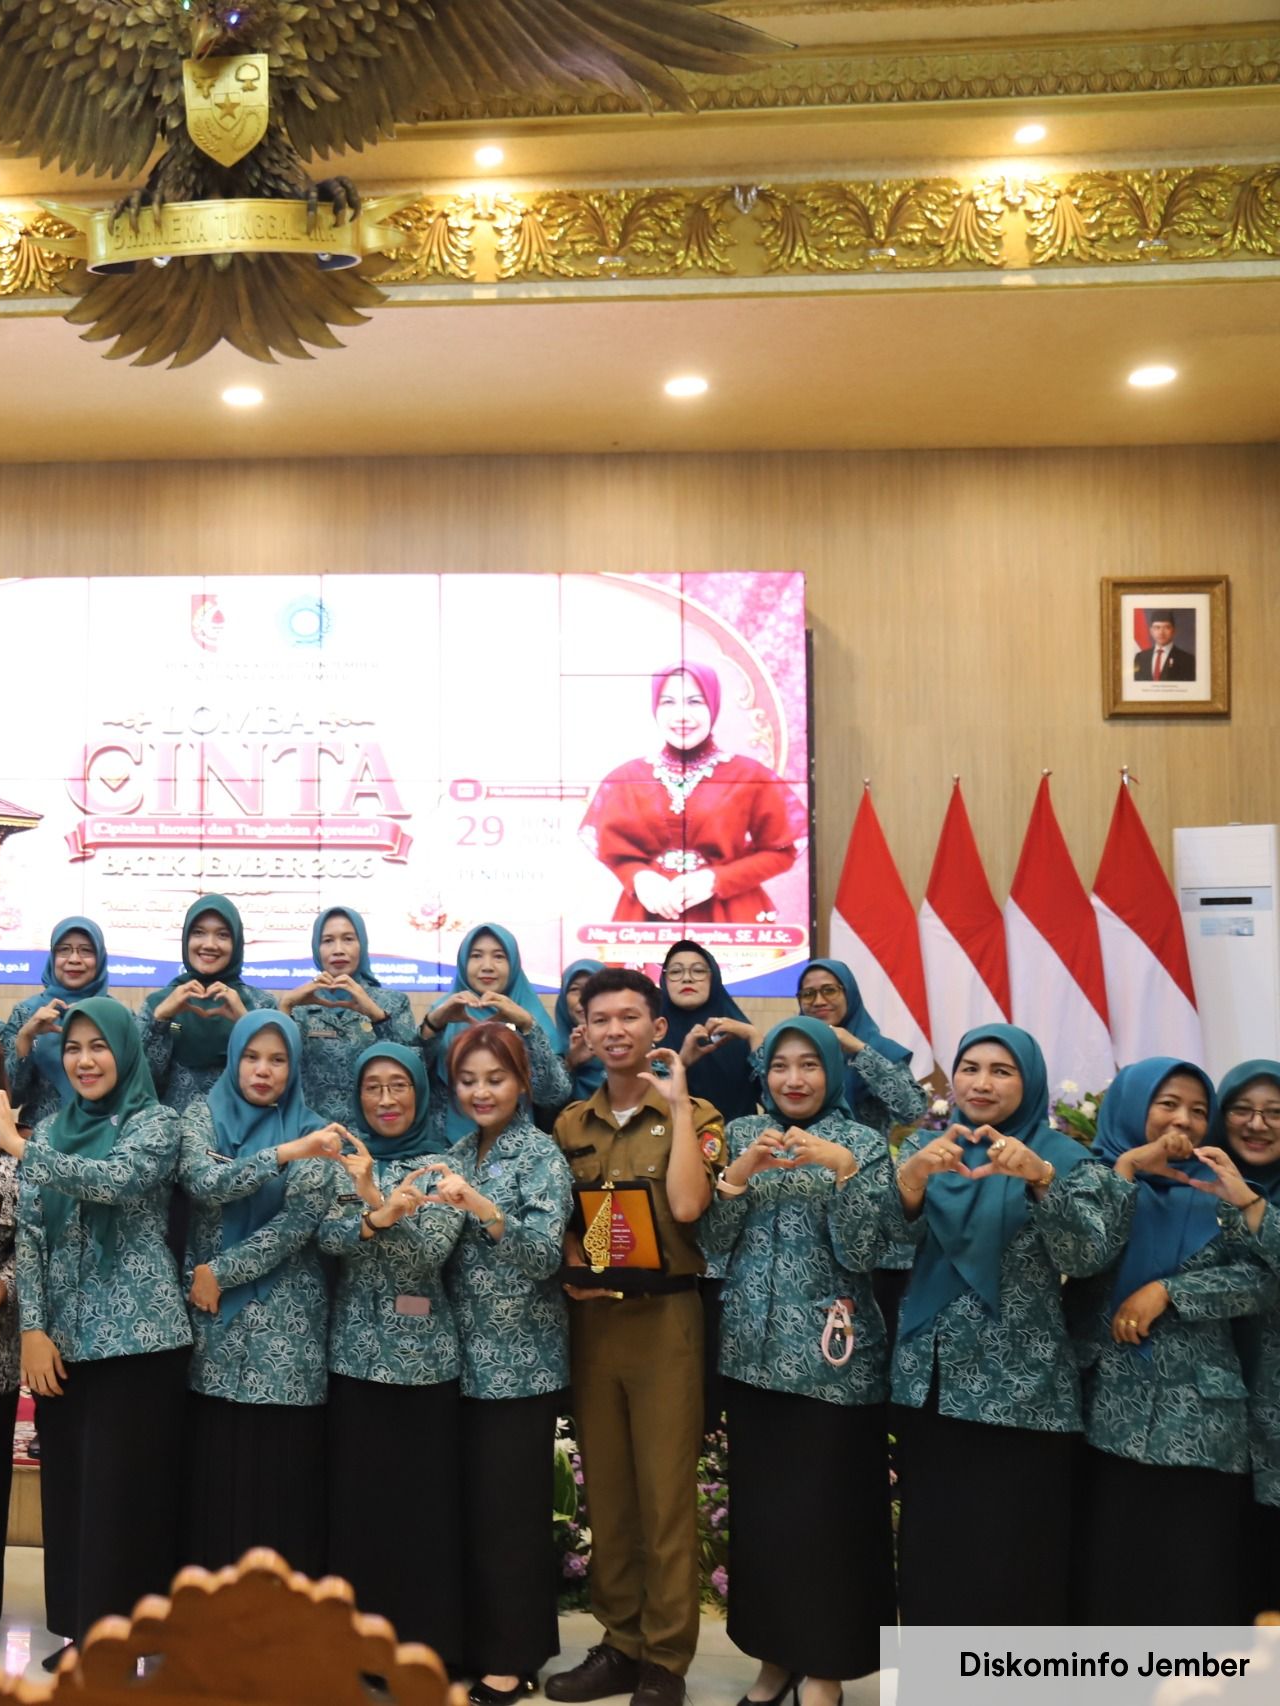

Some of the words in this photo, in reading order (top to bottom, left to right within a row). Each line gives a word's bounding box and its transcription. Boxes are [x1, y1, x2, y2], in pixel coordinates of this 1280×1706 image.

[215, 214, 301, 241] TUNGGAL
[161, 706, 314, 735] LOMBA
[65, 740, 411, 818] CINTA
[207, 822, 232, 836] dan
[456, 815, 505, 846] 29
[191, 856, 307, 878] JEMBER
[311, 857, 375, 879] 2026
[735, 929, 755, 943] SE.
[757, 929, 792, 944] M.Sc.
